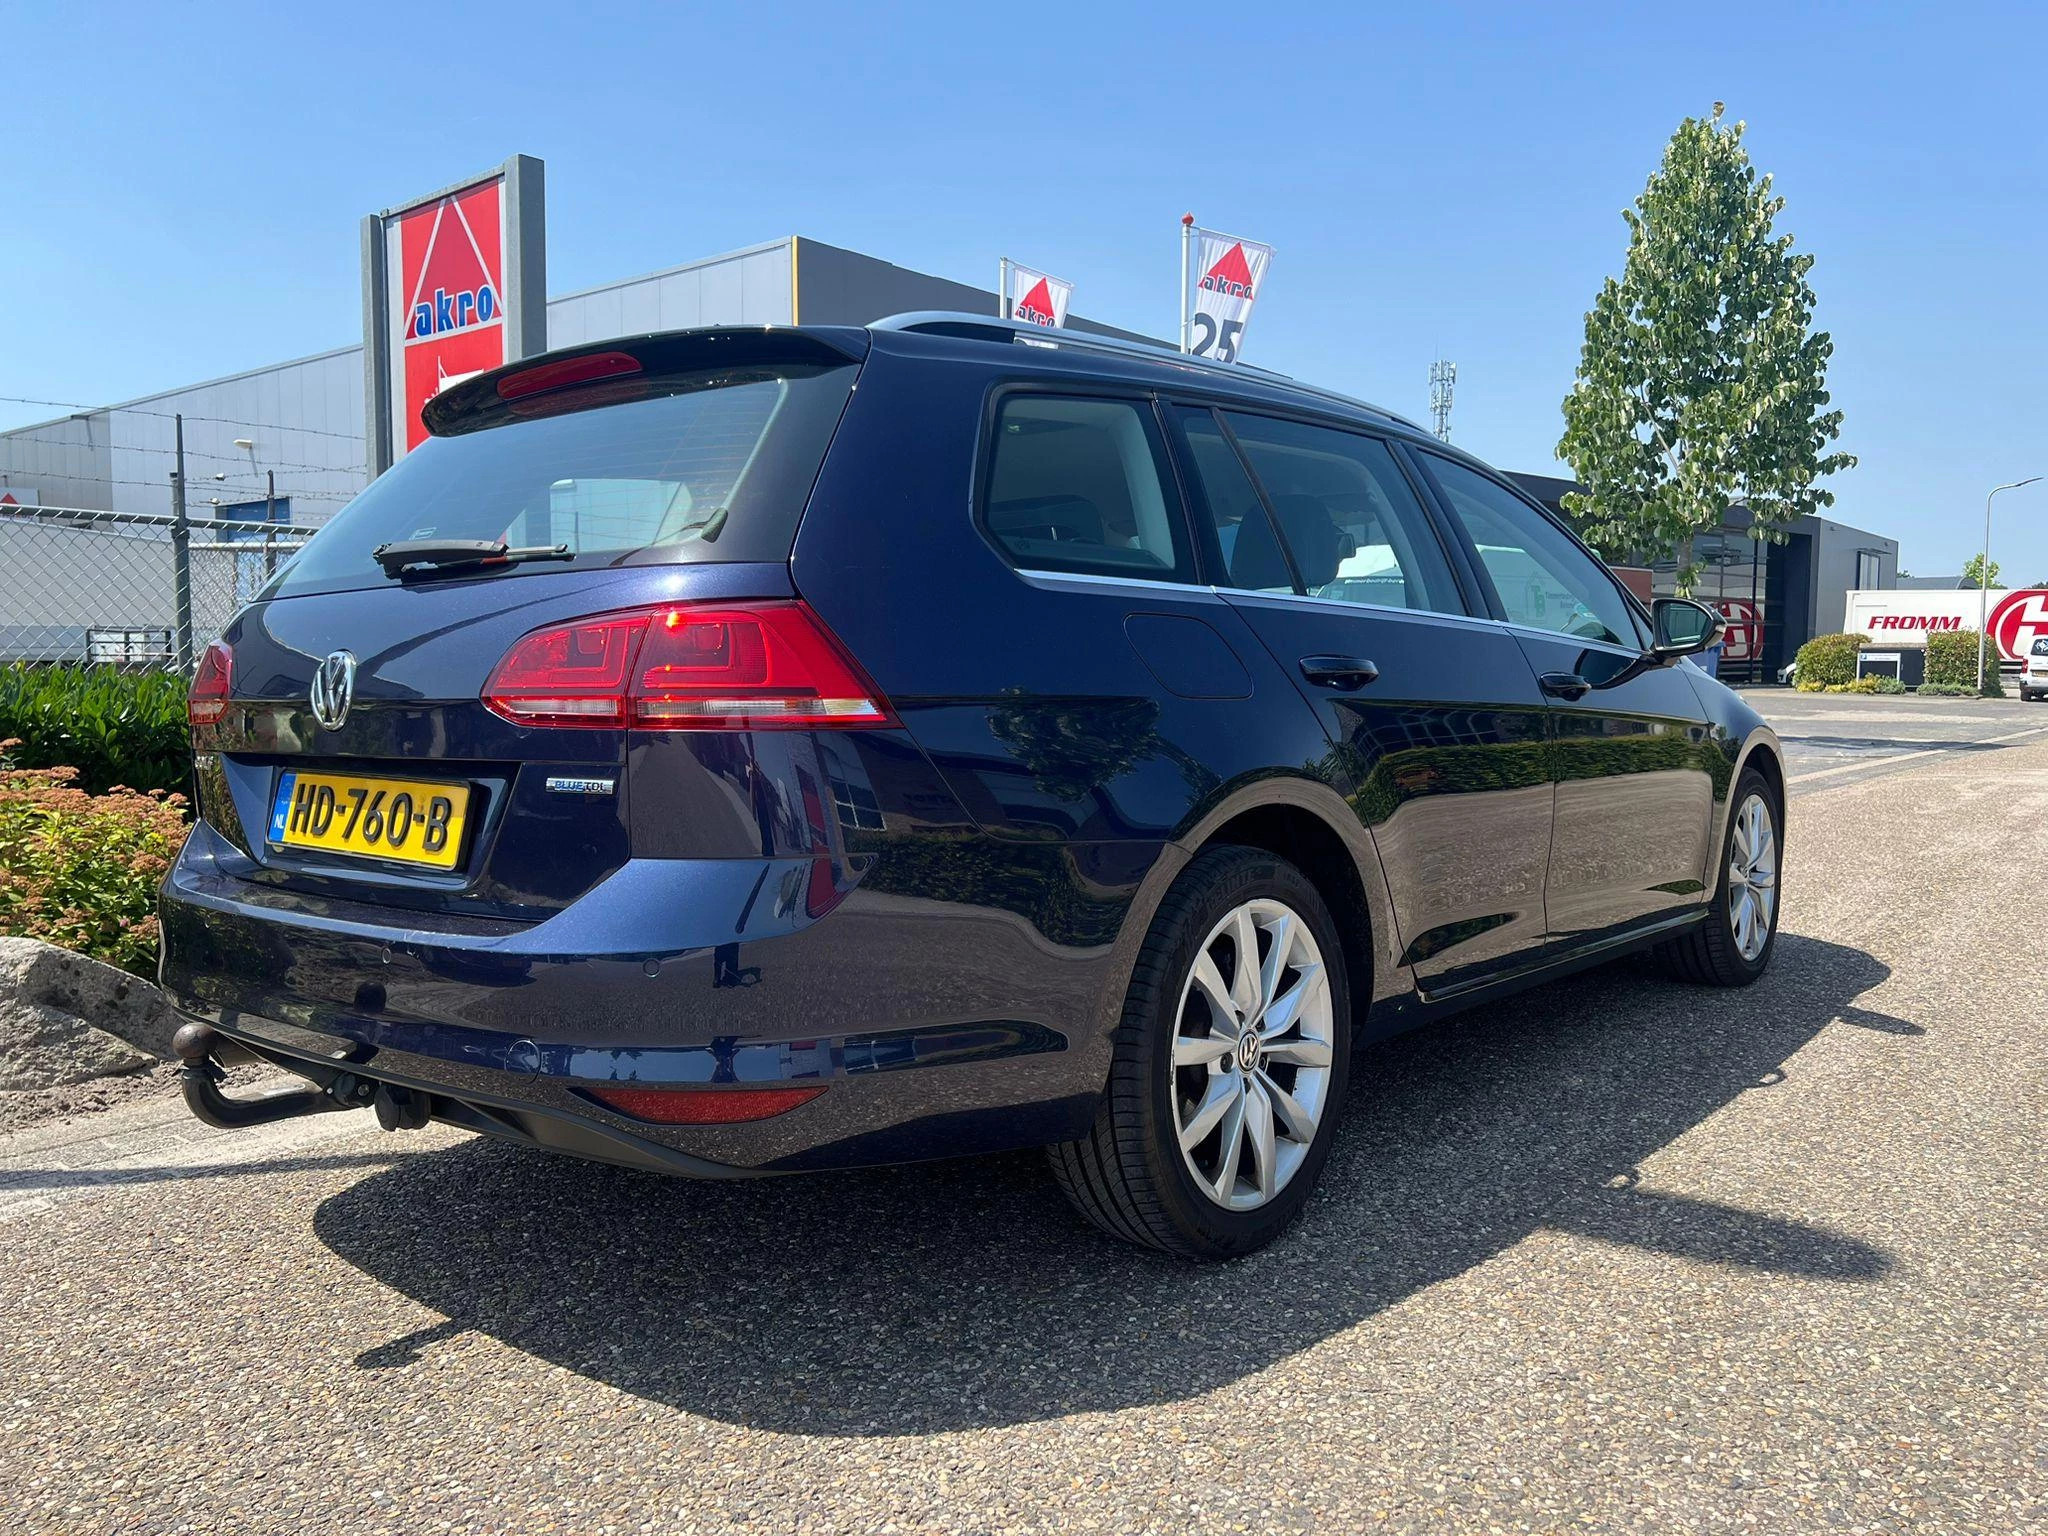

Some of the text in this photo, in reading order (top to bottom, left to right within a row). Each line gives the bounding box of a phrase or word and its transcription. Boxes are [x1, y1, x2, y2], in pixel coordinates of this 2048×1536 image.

[1203, 273, 1253, 300] akro
[415, 284, 494, 338] akro
[1018, 305, 1056, 328] akro
[1191, 312, 1243, 364] 25
[1868, 616, 1962, 630] FROMM
[274, 814, 285, 829] NL
[289, 783, 453, 853] HD-760-B
